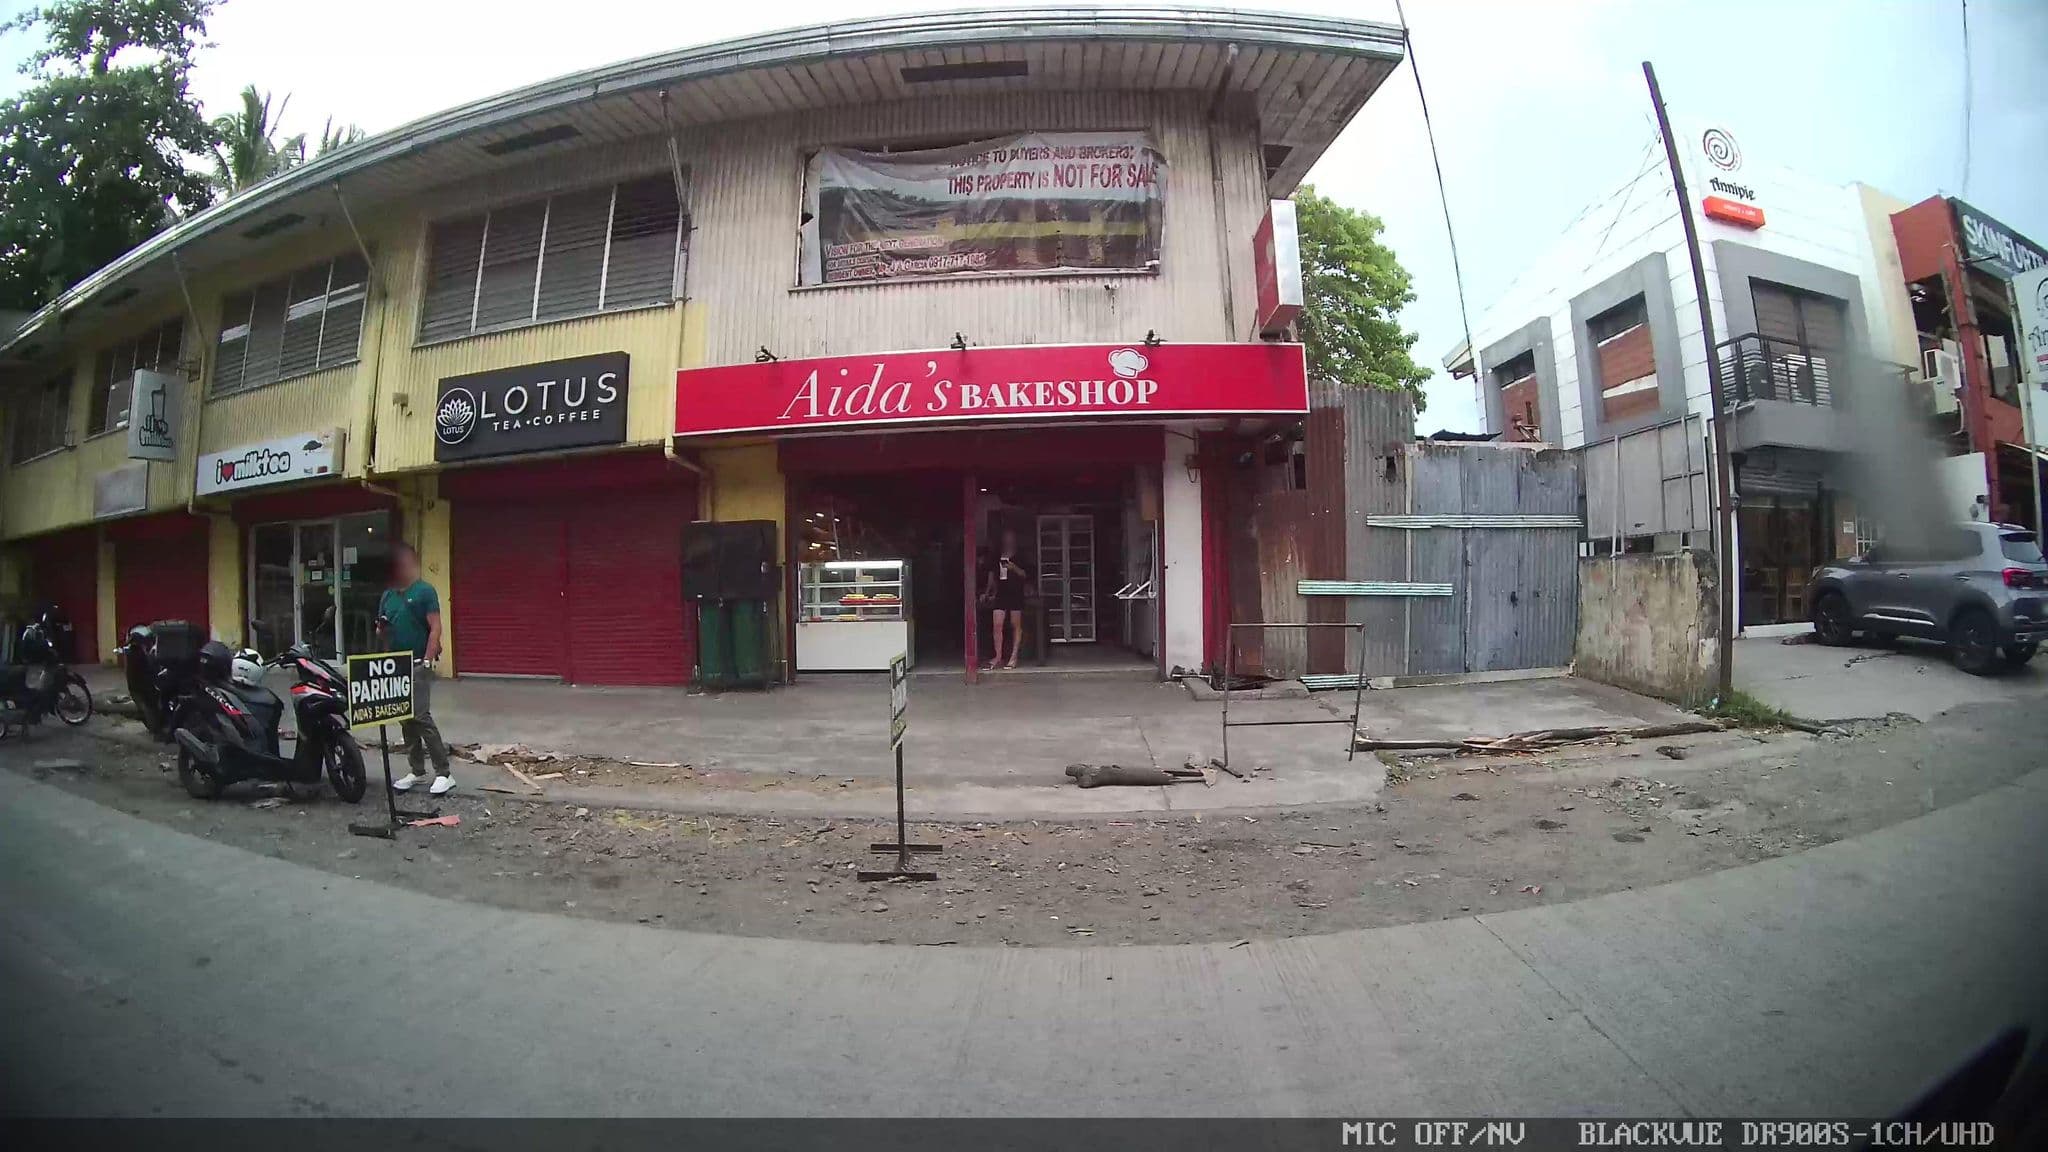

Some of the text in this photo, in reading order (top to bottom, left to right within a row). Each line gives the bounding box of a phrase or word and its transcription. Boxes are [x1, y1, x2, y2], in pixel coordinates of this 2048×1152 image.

[992, 150, 1007, 163] TO
[1009, 147, 1050, 161] BUYERS
[1053, 147, 1076, 160] AND
[948, 162, 1158, 195] THIS PROPERTY IS NOT FOR SALE
[481, 372, 617, 419] LOTUS
[777, 361, 1158, 420] Aida's BAKESHOP
[443, 425, 464, 435] LOTUS
[369, 658, 396, 677] NO
[351, 675, 410, 704] PARKING
